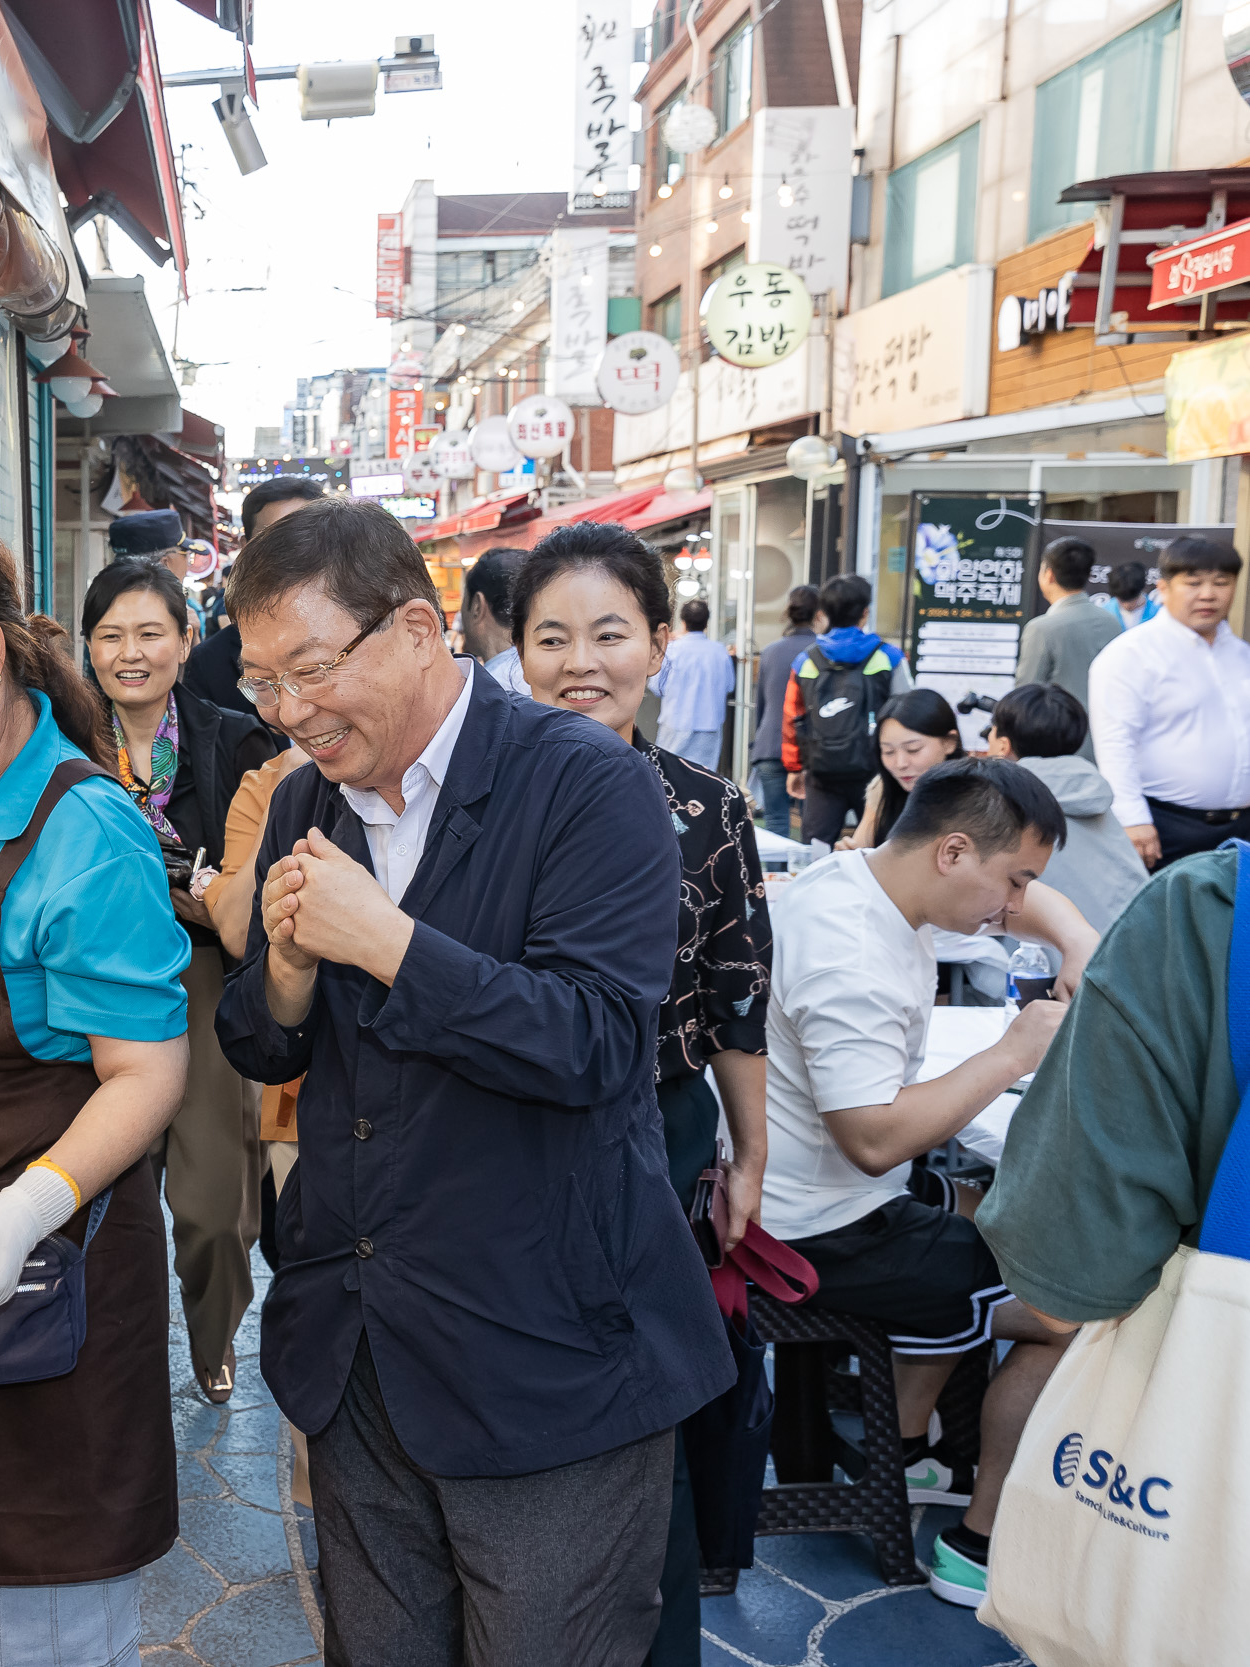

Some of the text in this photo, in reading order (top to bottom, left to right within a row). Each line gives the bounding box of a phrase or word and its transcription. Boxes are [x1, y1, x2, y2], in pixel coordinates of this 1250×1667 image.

[729, 273, 792, 309] 우동
[725, 326, 796, 356] 김밥
[616, 362, 661, 391] 떡
[935, 558, 1025, 582] 화양연화
[934, 582, 1022, 606] 맥주축제
[1082, 1449, 1174, 1520] S&C
